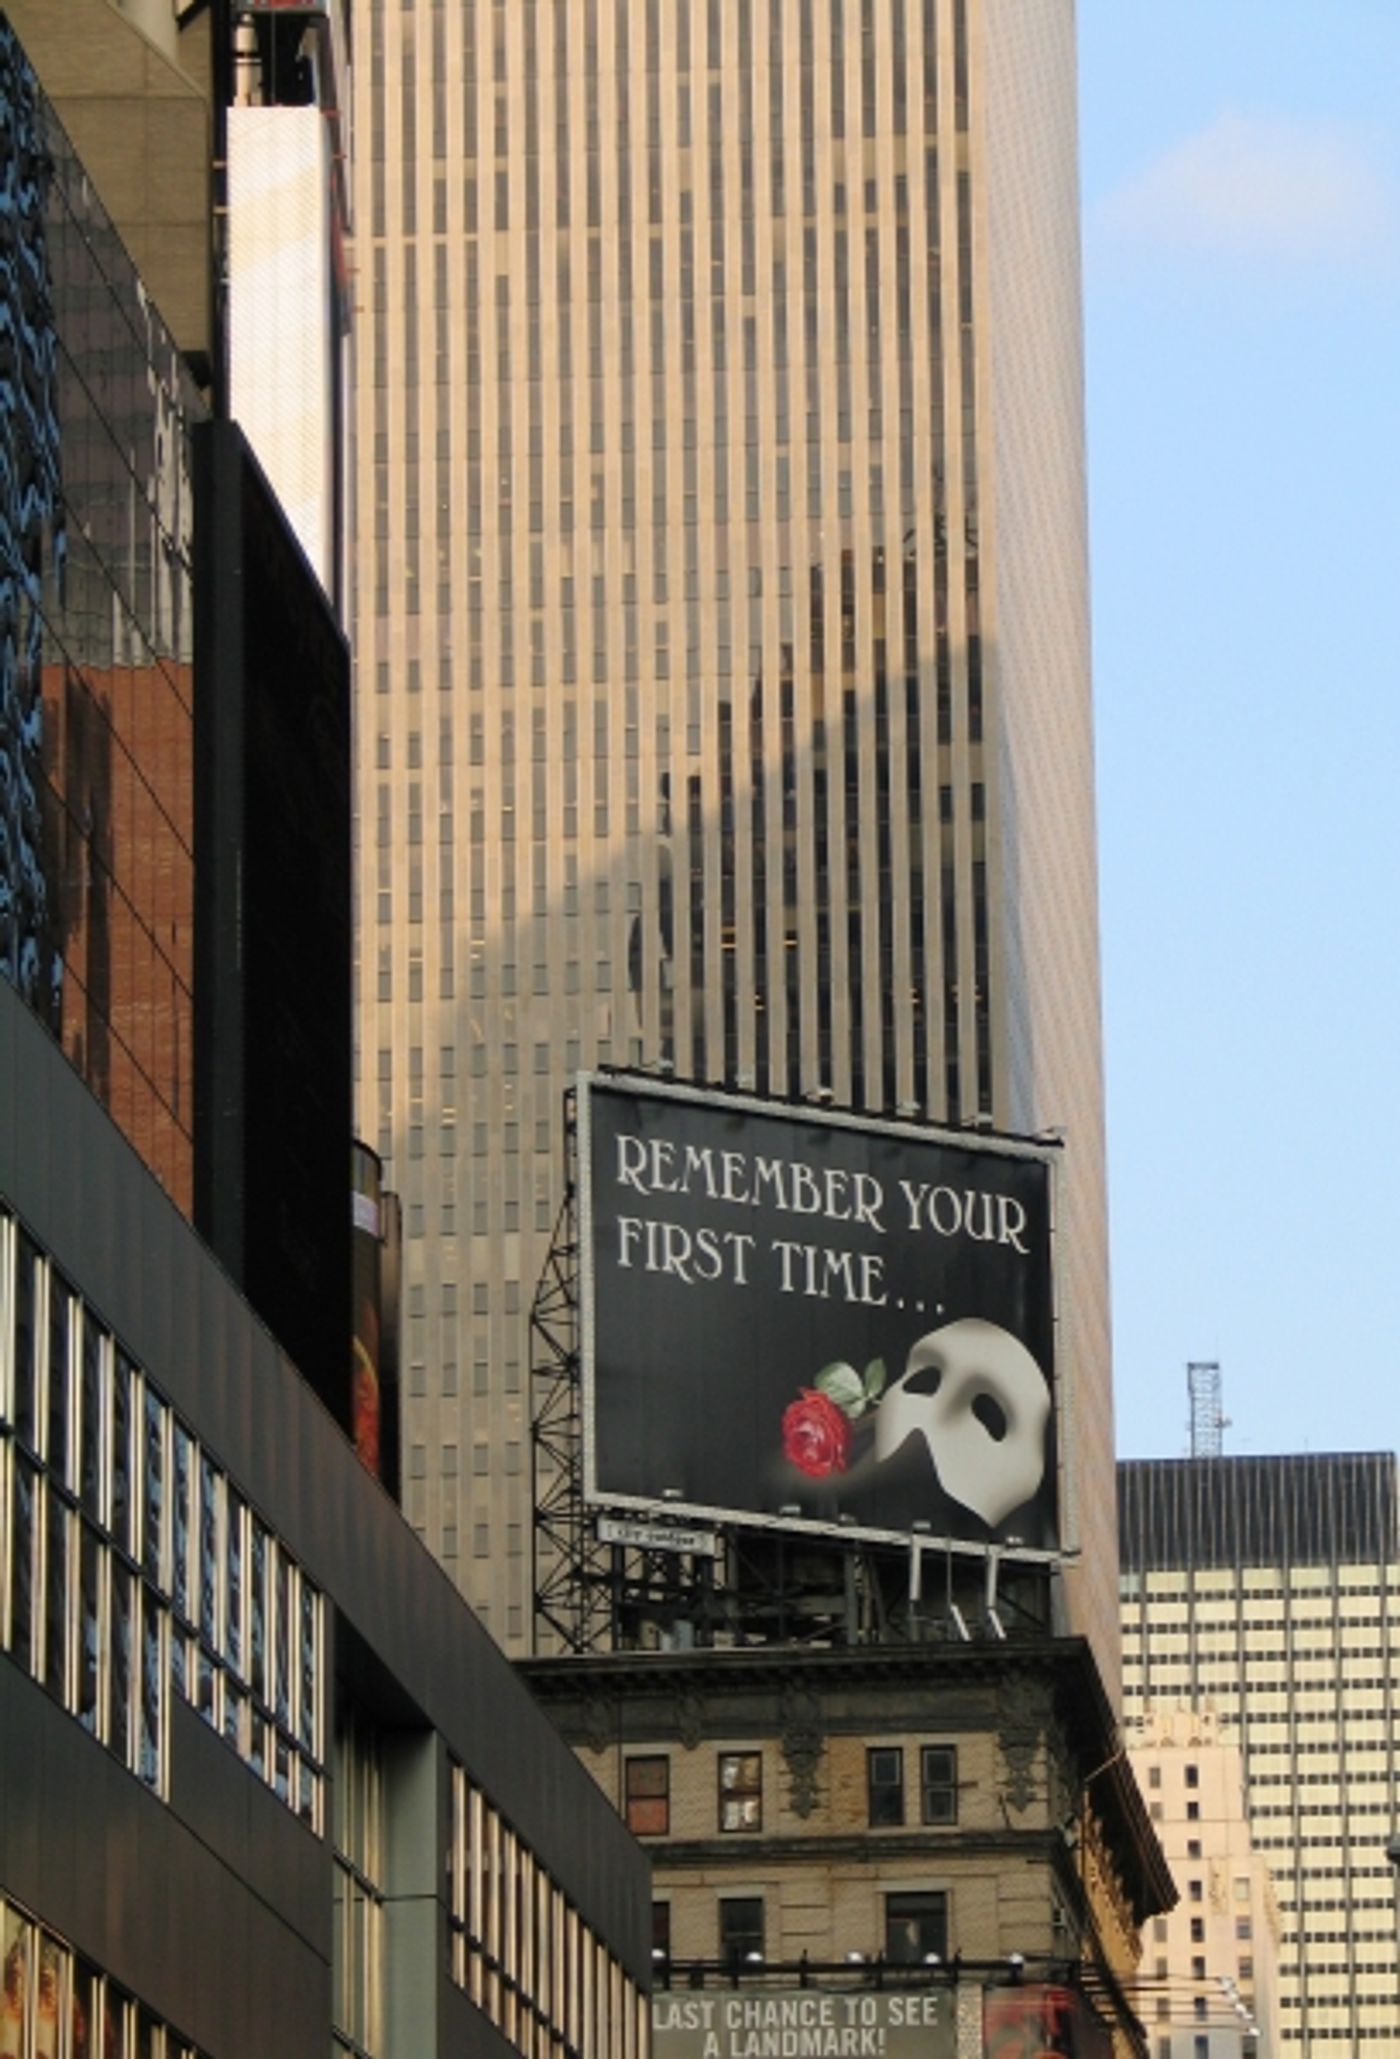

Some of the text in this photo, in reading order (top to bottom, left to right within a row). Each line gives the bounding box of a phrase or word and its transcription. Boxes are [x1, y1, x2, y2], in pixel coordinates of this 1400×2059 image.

[616, 1133, 1030, 1254] REMEMBER YOUR
[616, 1216, 756, 1284] FIRST
[652, 1996, 938, 2030] LAST CHANCE TO SEE
[703, 2027, 886, 2057] A LANDMARK!
